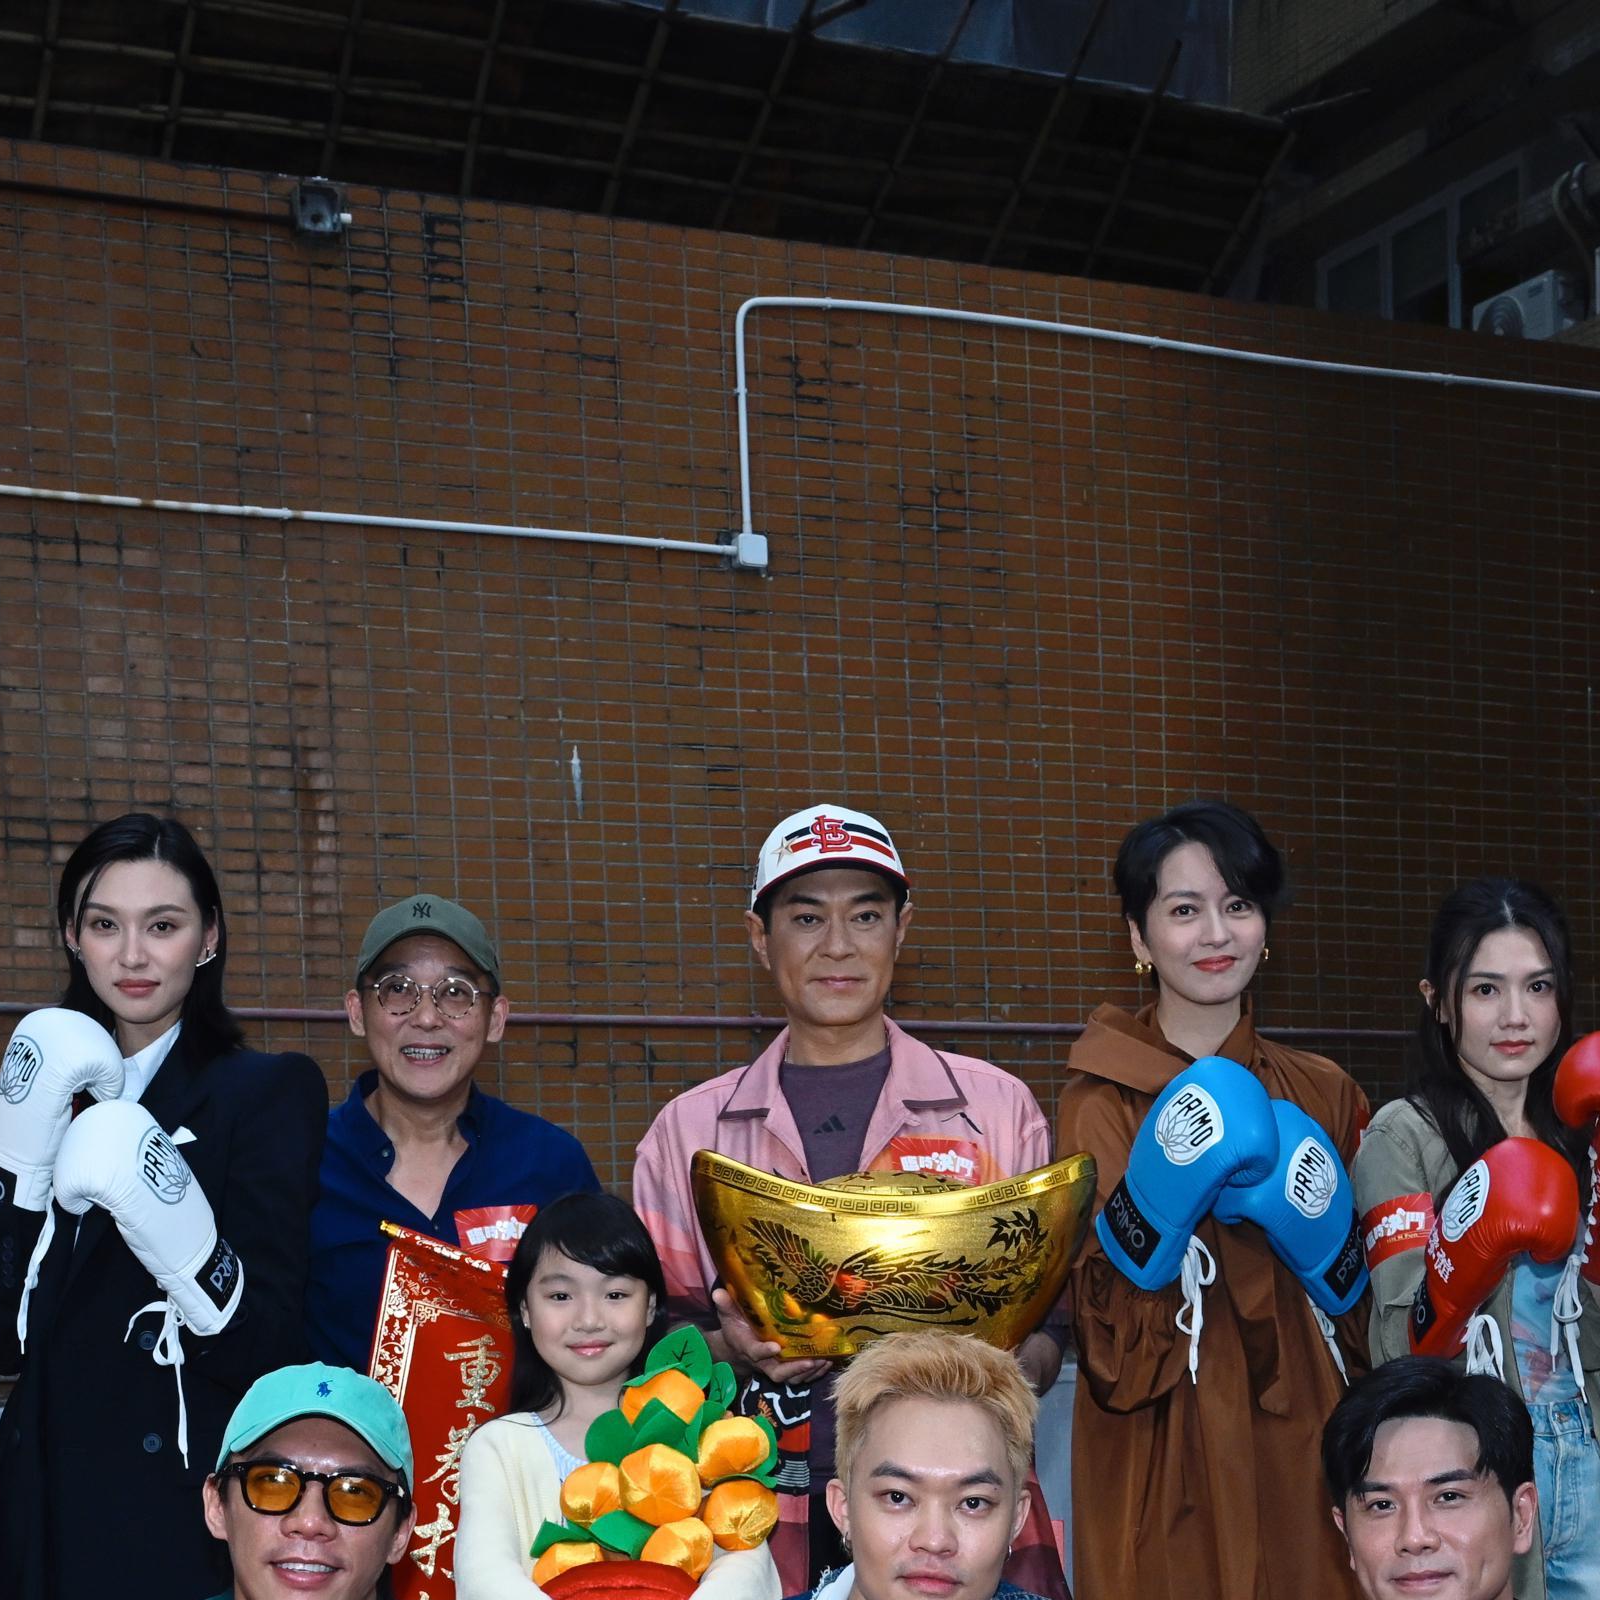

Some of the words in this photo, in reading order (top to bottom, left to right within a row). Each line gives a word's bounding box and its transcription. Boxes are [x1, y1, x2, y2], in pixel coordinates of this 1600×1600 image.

[412, 901, 432, 919] NY
[6, 1042, 37, 1083] PRIMO
[1173, 1092, 1214, 1147] PRIMO
[1293, 1146, 1326, 1204] PRIMO
[1458, 1168, 1481, 1225] PRIMO
[1111, 1191, 1146, 1249] PRIMO
